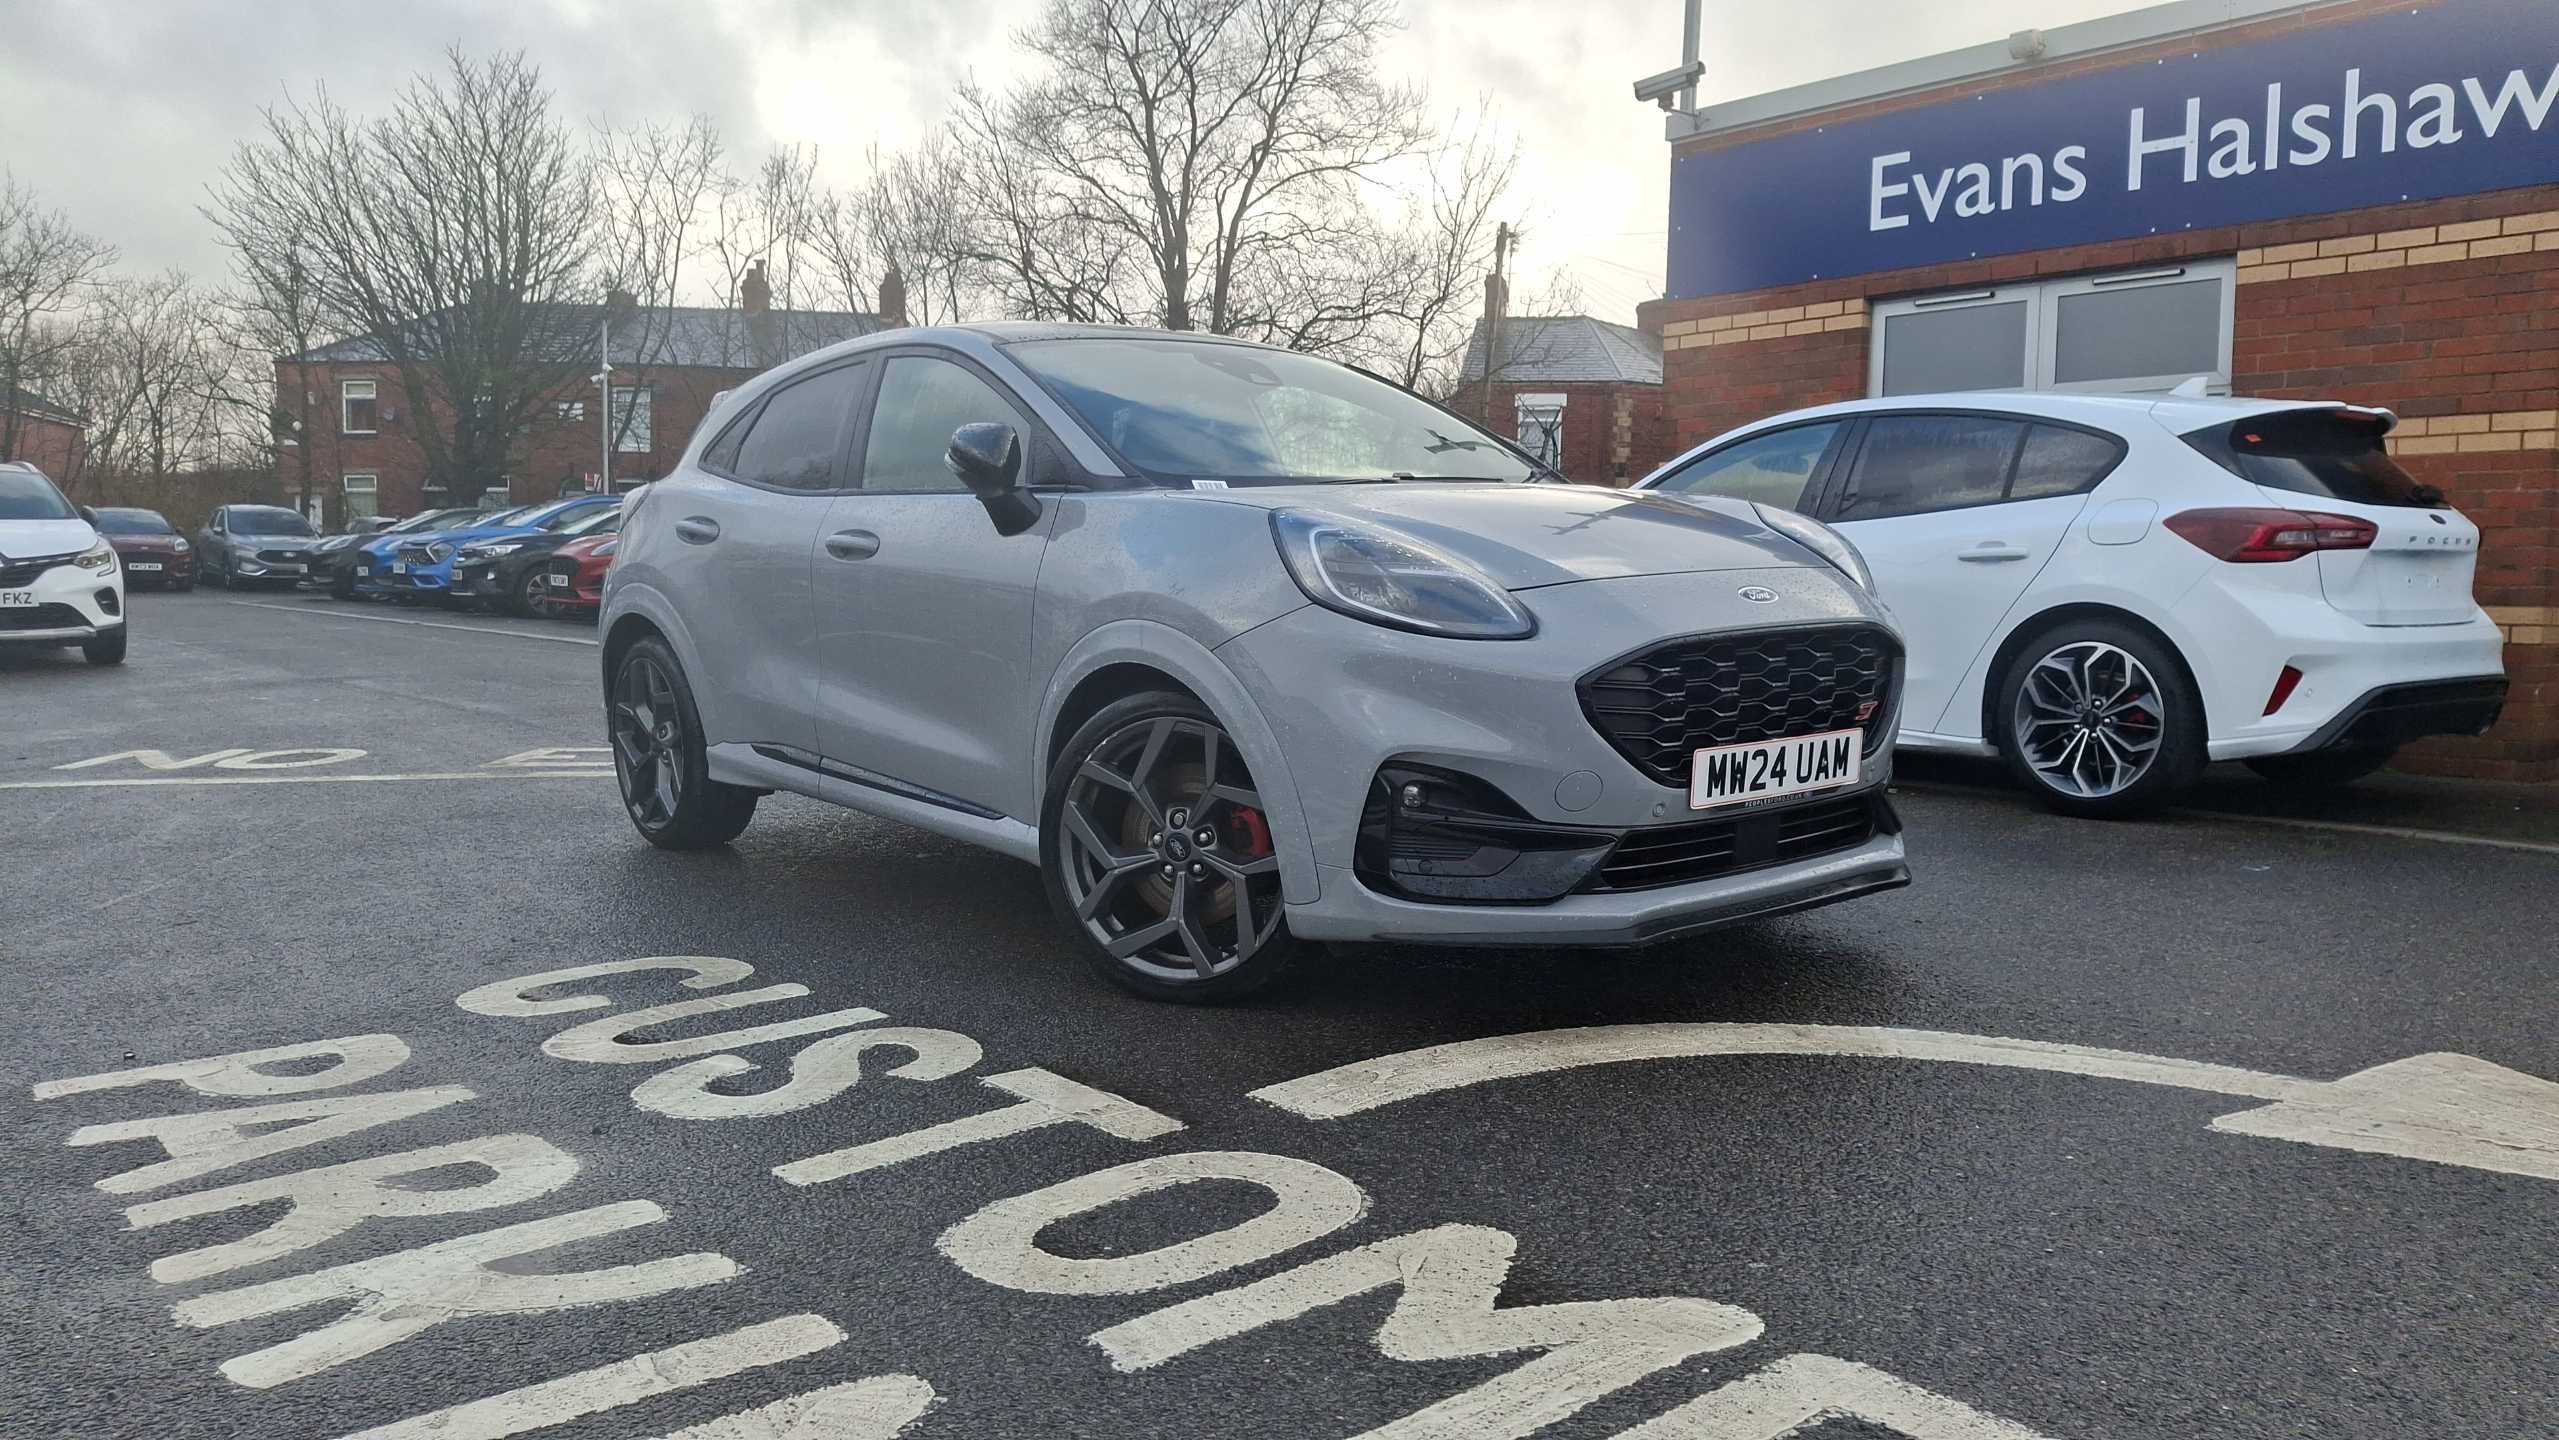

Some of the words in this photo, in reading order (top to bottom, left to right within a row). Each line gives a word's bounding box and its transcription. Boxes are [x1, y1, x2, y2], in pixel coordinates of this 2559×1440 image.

[1868, 145, 2088, 233] Evans
[2127, 60, 2559, 193] Halshaw
[2, 592, 33, 605] FKZ
[52, 748, 368, 771] NO
[1705, 746, 1787, 798] MW24
[1796, 737, 1850, 784] UAM
